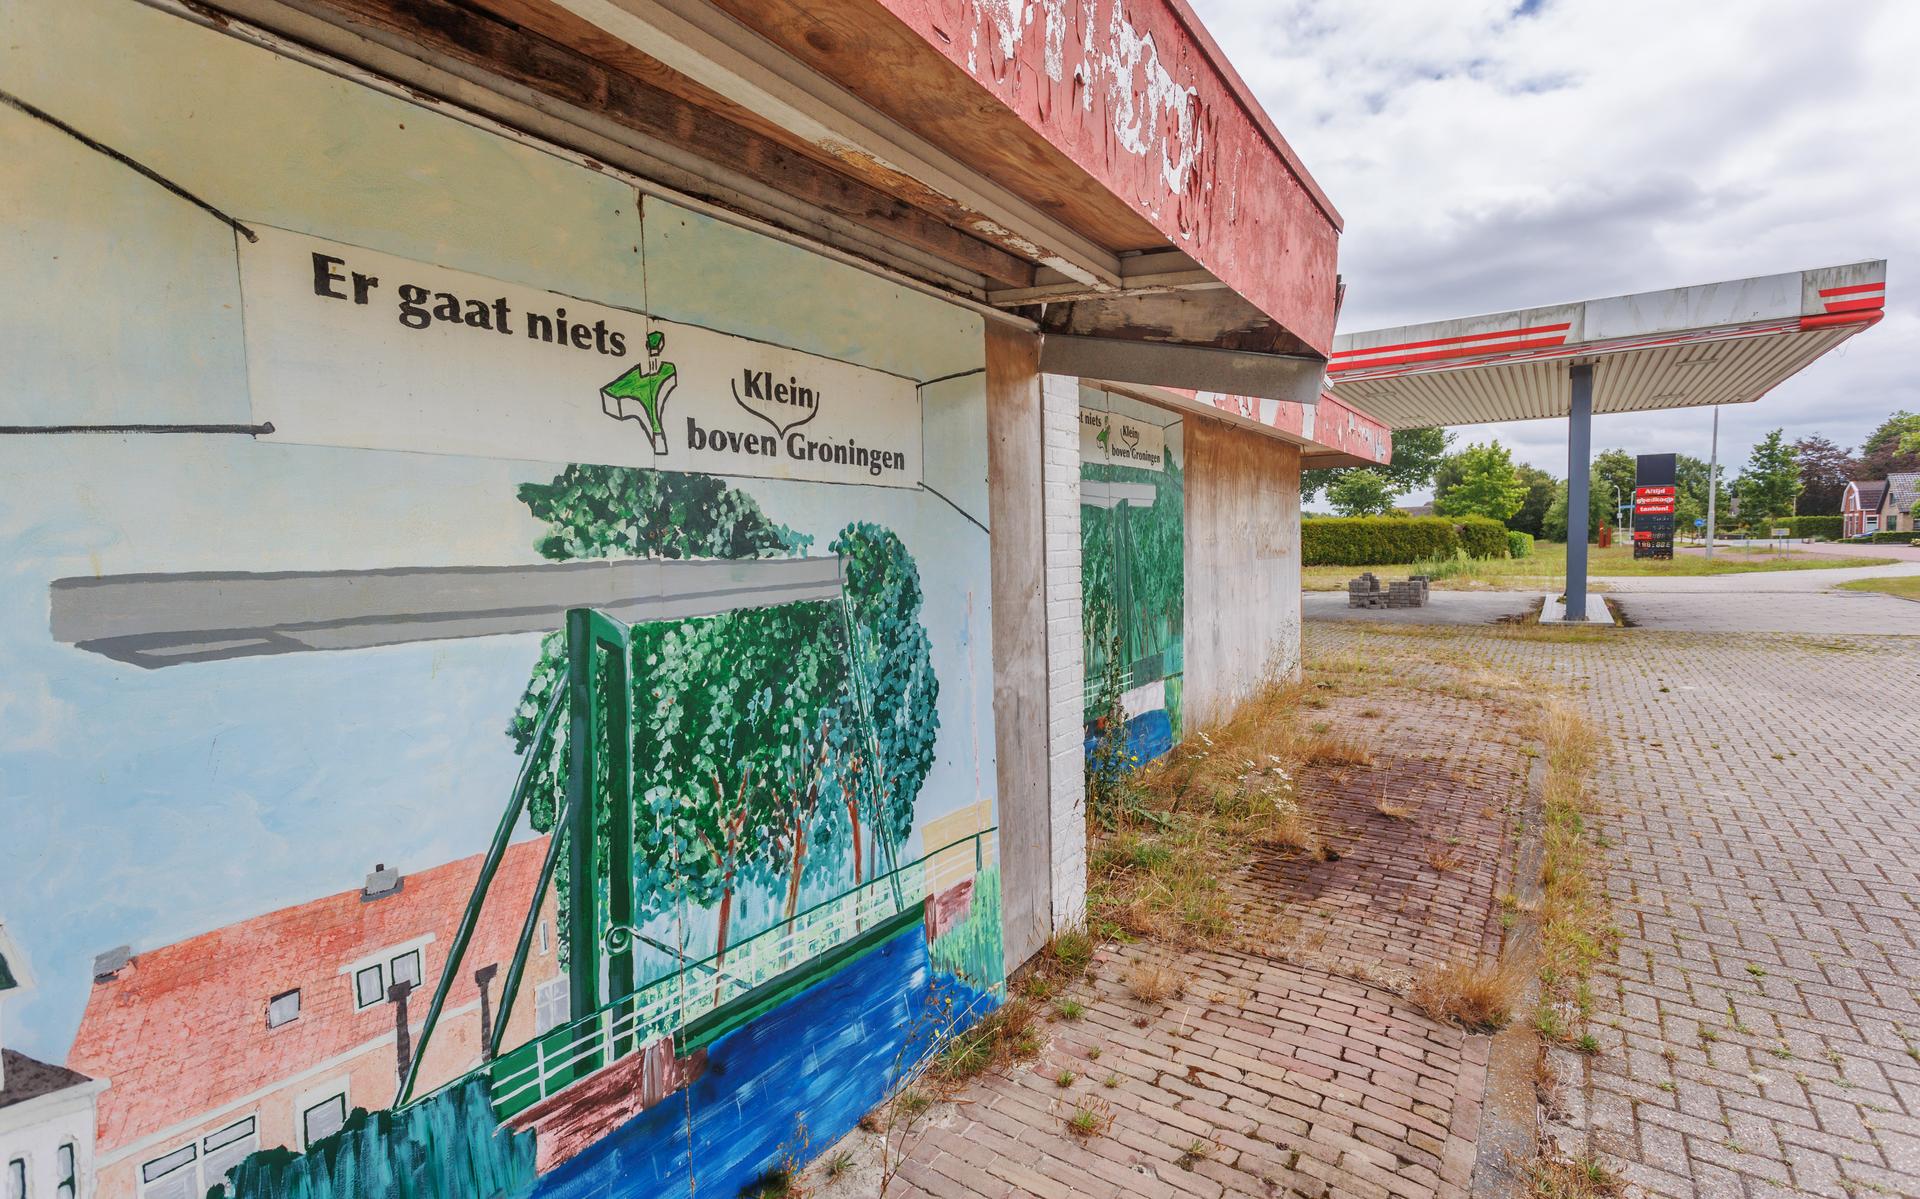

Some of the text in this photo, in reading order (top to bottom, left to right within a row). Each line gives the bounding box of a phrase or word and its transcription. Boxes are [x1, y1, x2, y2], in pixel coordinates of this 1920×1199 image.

[312, 251, 627, 357] Er gaat niets
[743, 368, 814, 409] Klein
[1085, 412, 1102, 427] niets
[1122, 425, 1140, 439] Klein
[686, 417, 905, 476] boven Groningen
[1112, 444, 1160, 466] boven Groningen
